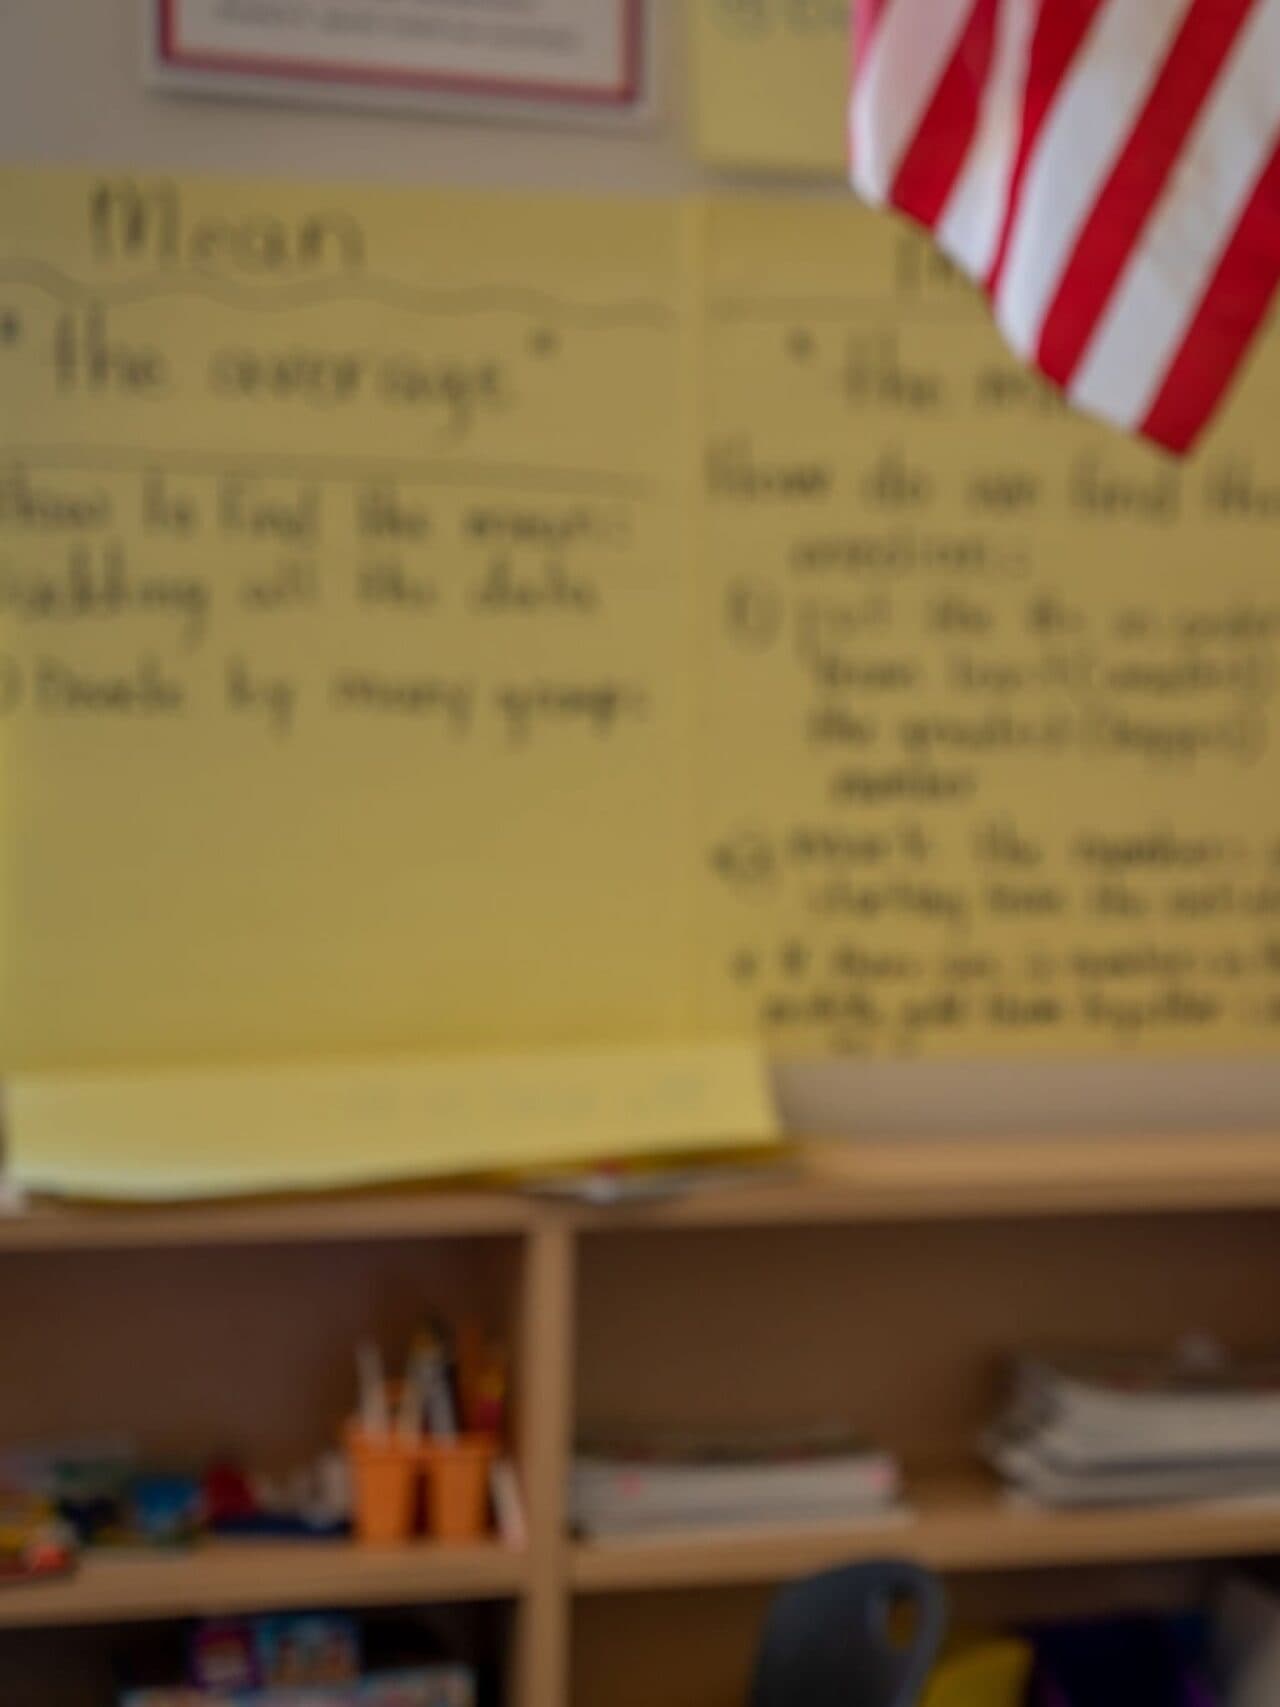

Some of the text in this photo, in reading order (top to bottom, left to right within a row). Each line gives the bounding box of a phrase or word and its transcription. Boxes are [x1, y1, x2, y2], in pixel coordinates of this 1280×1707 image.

[89, 176, 365, 274] Mean
[56, 302, 515, 446] the average
